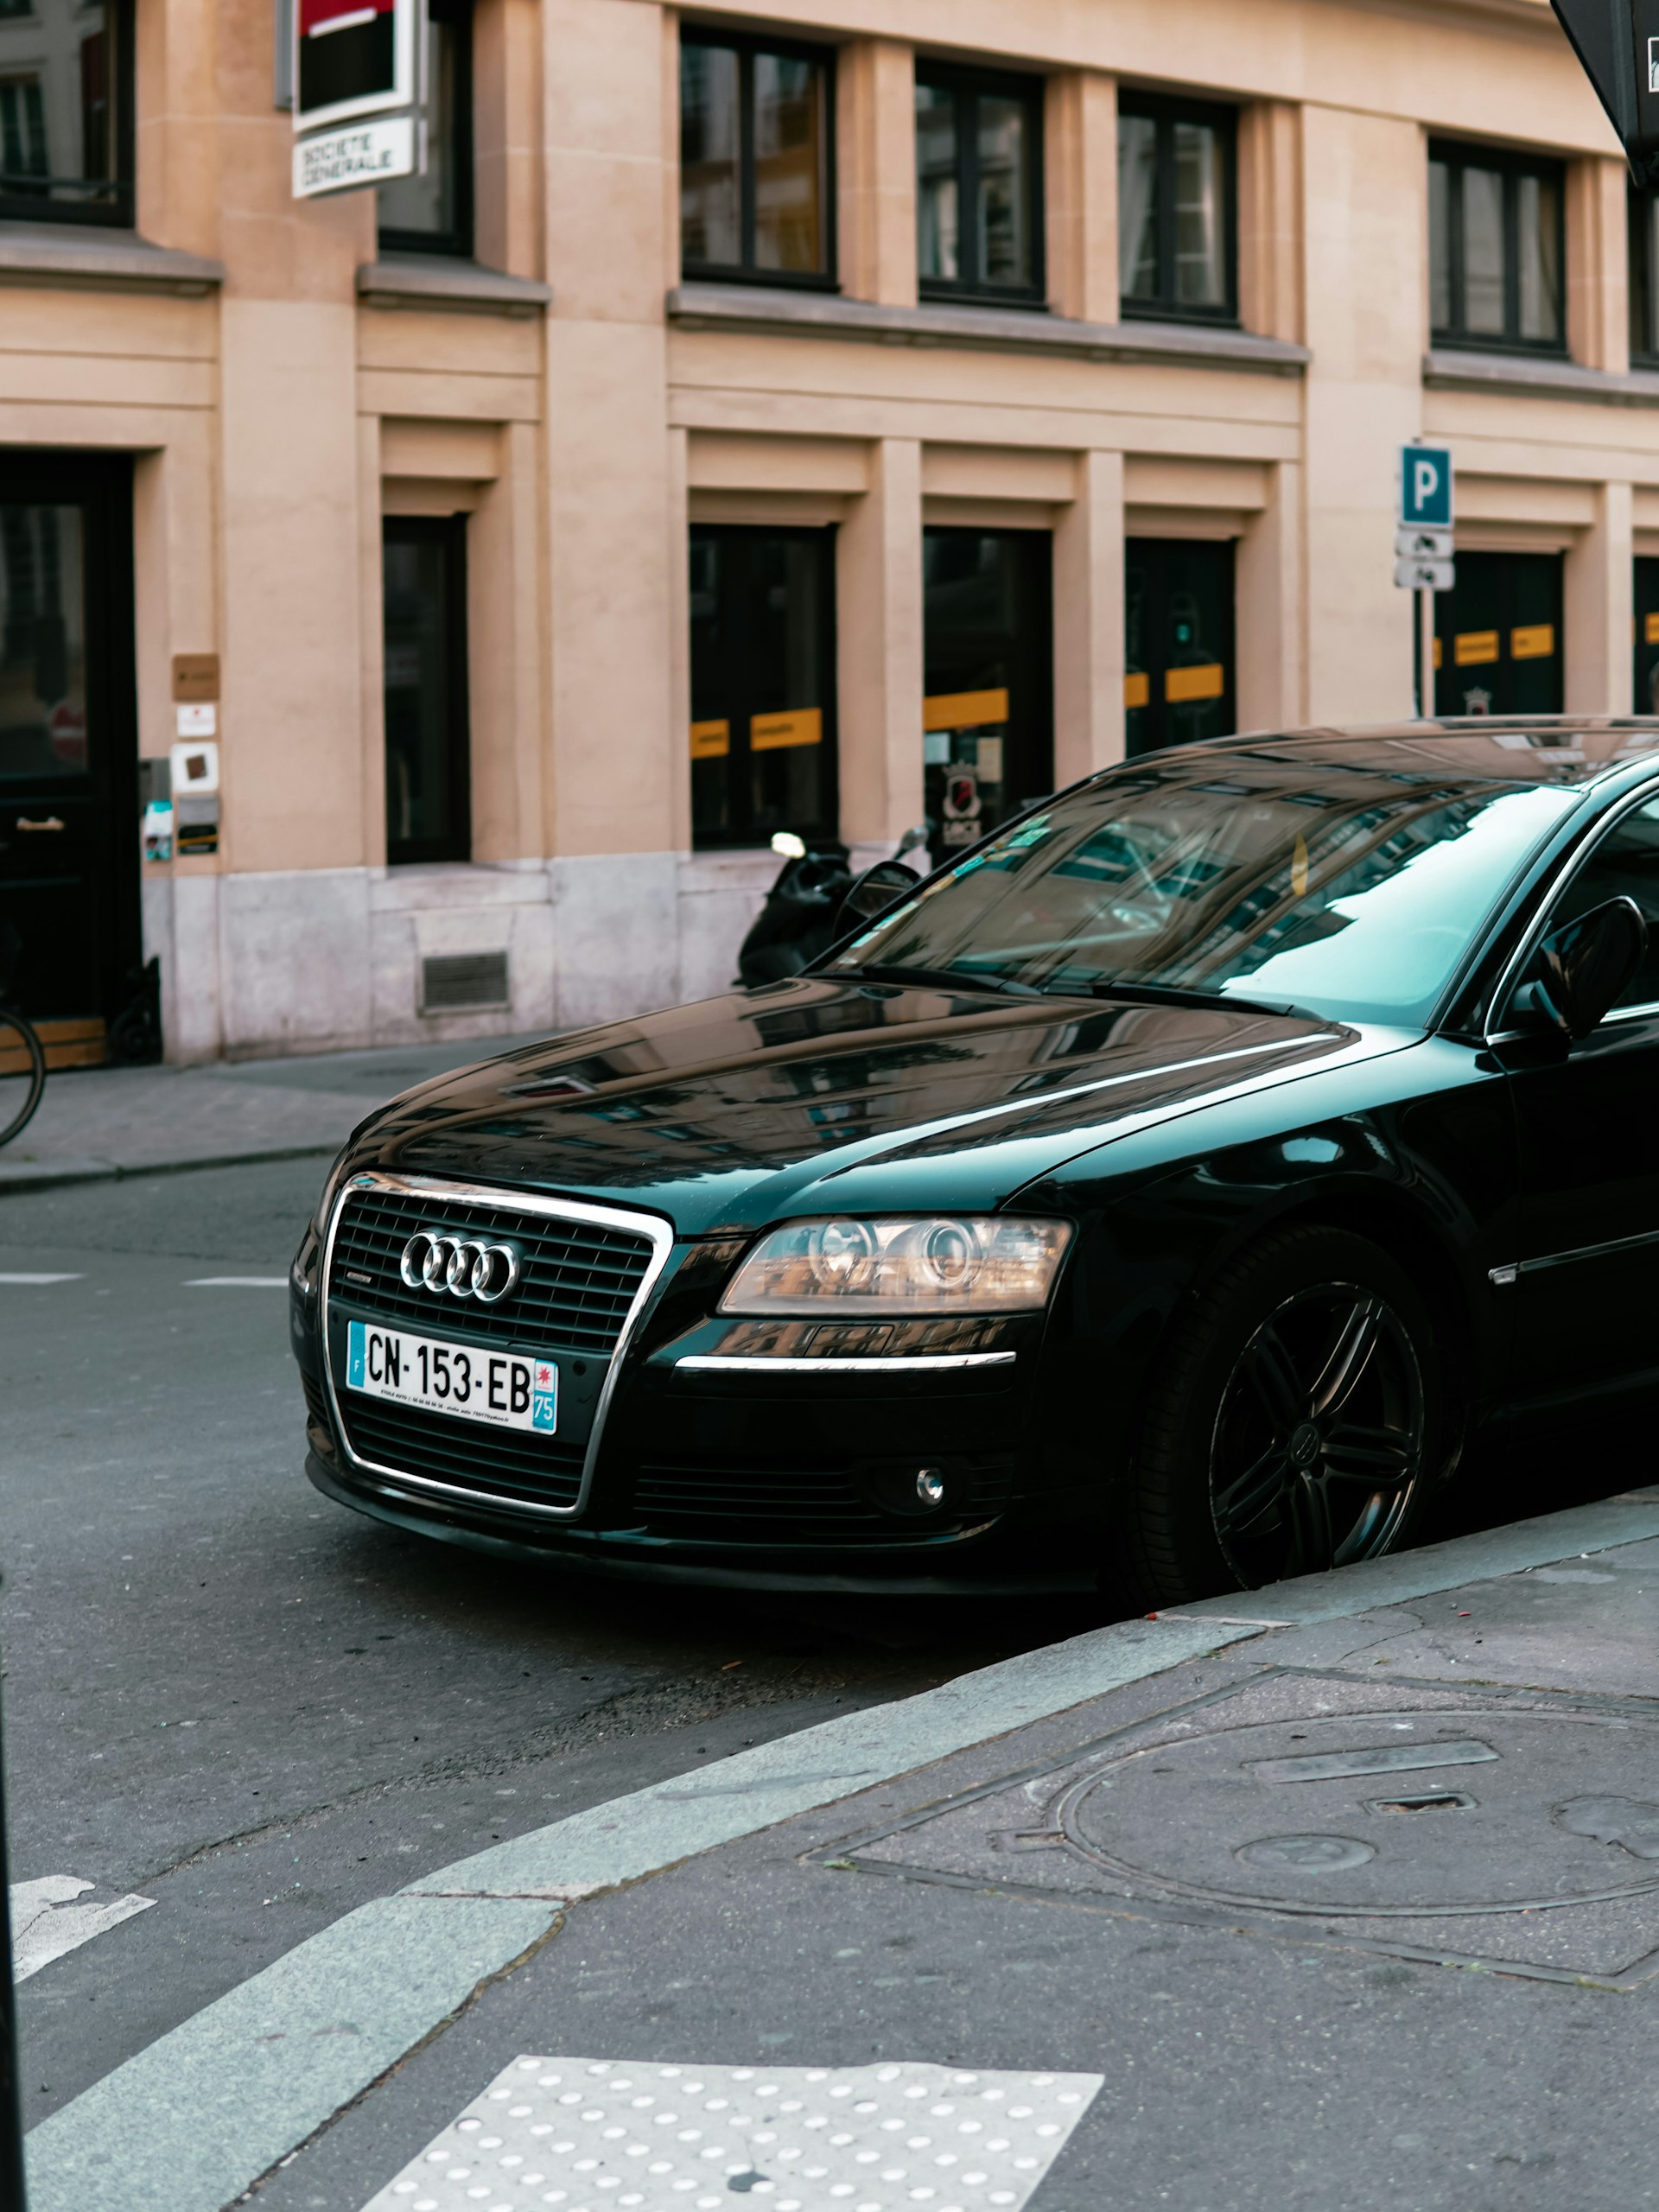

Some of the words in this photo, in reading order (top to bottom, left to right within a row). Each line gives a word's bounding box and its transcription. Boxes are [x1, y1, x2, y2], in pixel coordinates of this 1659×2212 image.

[1414, 460, 1439, 511] P
[353, 1359, 360, 1373] F
[368, 1333, 531, 1414] CN-153-EB
[534, 1395, 554, 1421] 75
